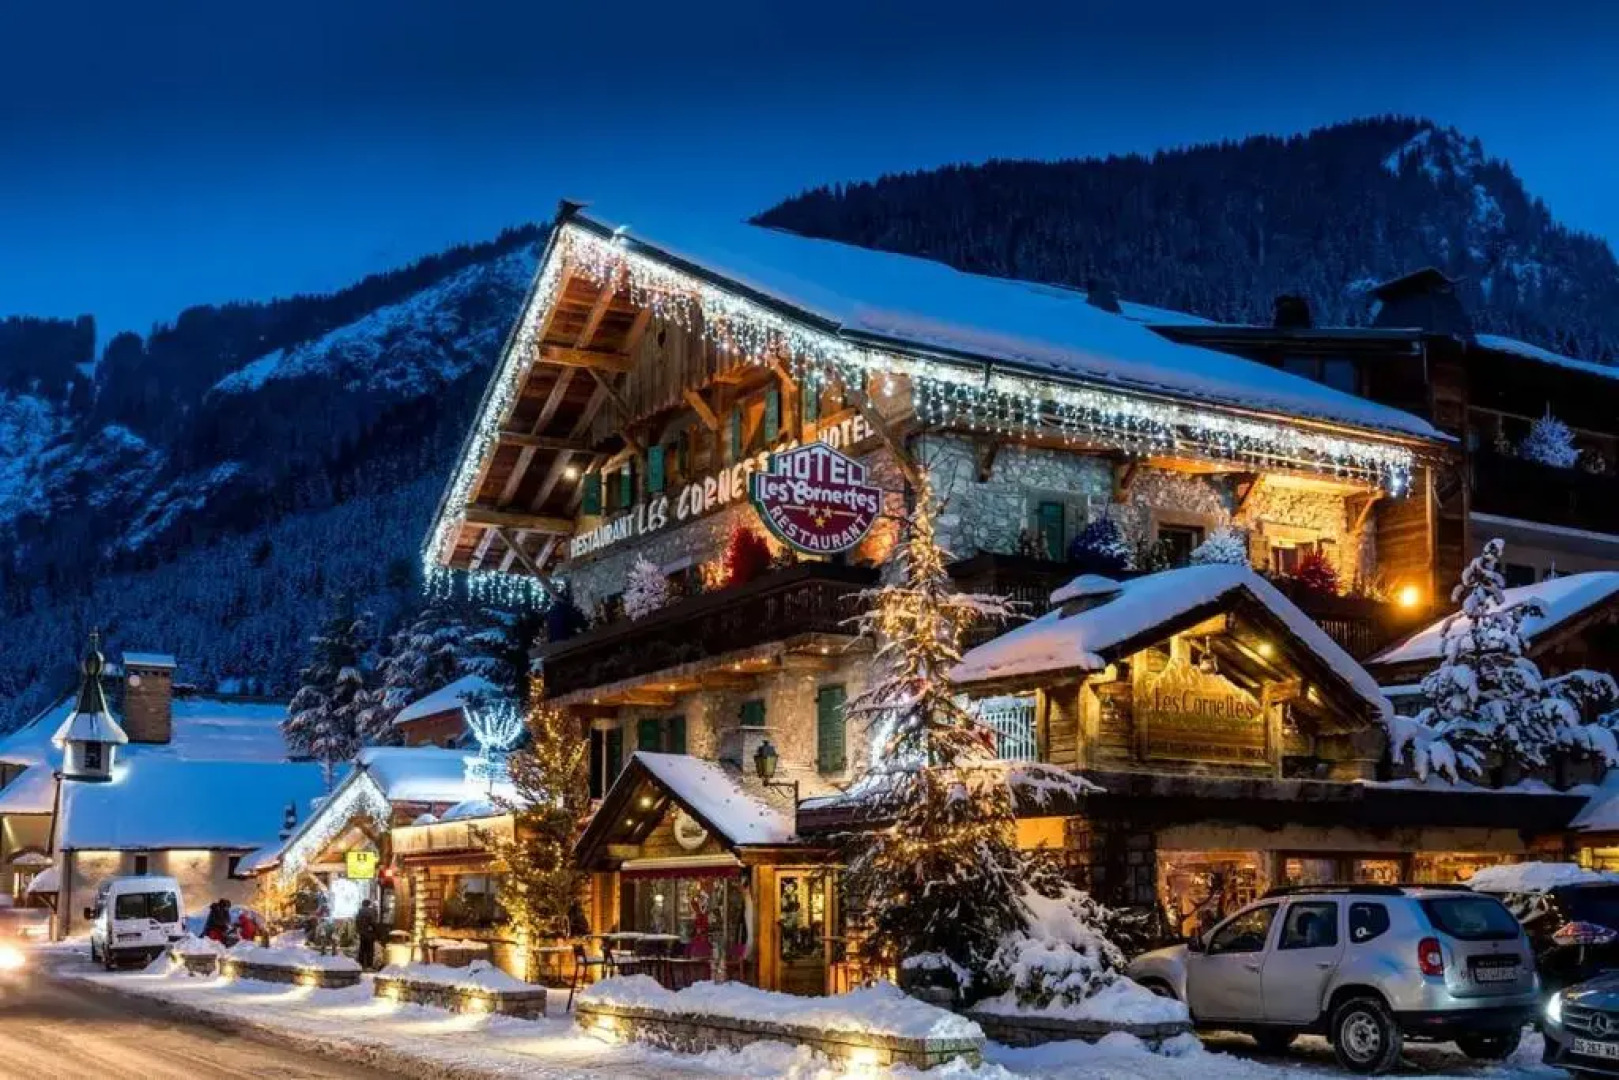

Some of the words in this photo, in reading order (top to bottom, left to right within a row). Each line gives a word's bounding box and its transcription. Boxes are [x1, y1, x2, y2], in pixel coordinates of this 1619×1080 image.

[570, 513, 635, 559] RESTAURANT
[637, 495, 669, 536] LES
[817, 414, 875, 450] HOTEL
[778, 445, 866, 486] HOTEL
[760, 475, 790, 502] Les
[786, 479, 877, 514] Cornettes
[769, 505, 868, 551] RESTAURANT
